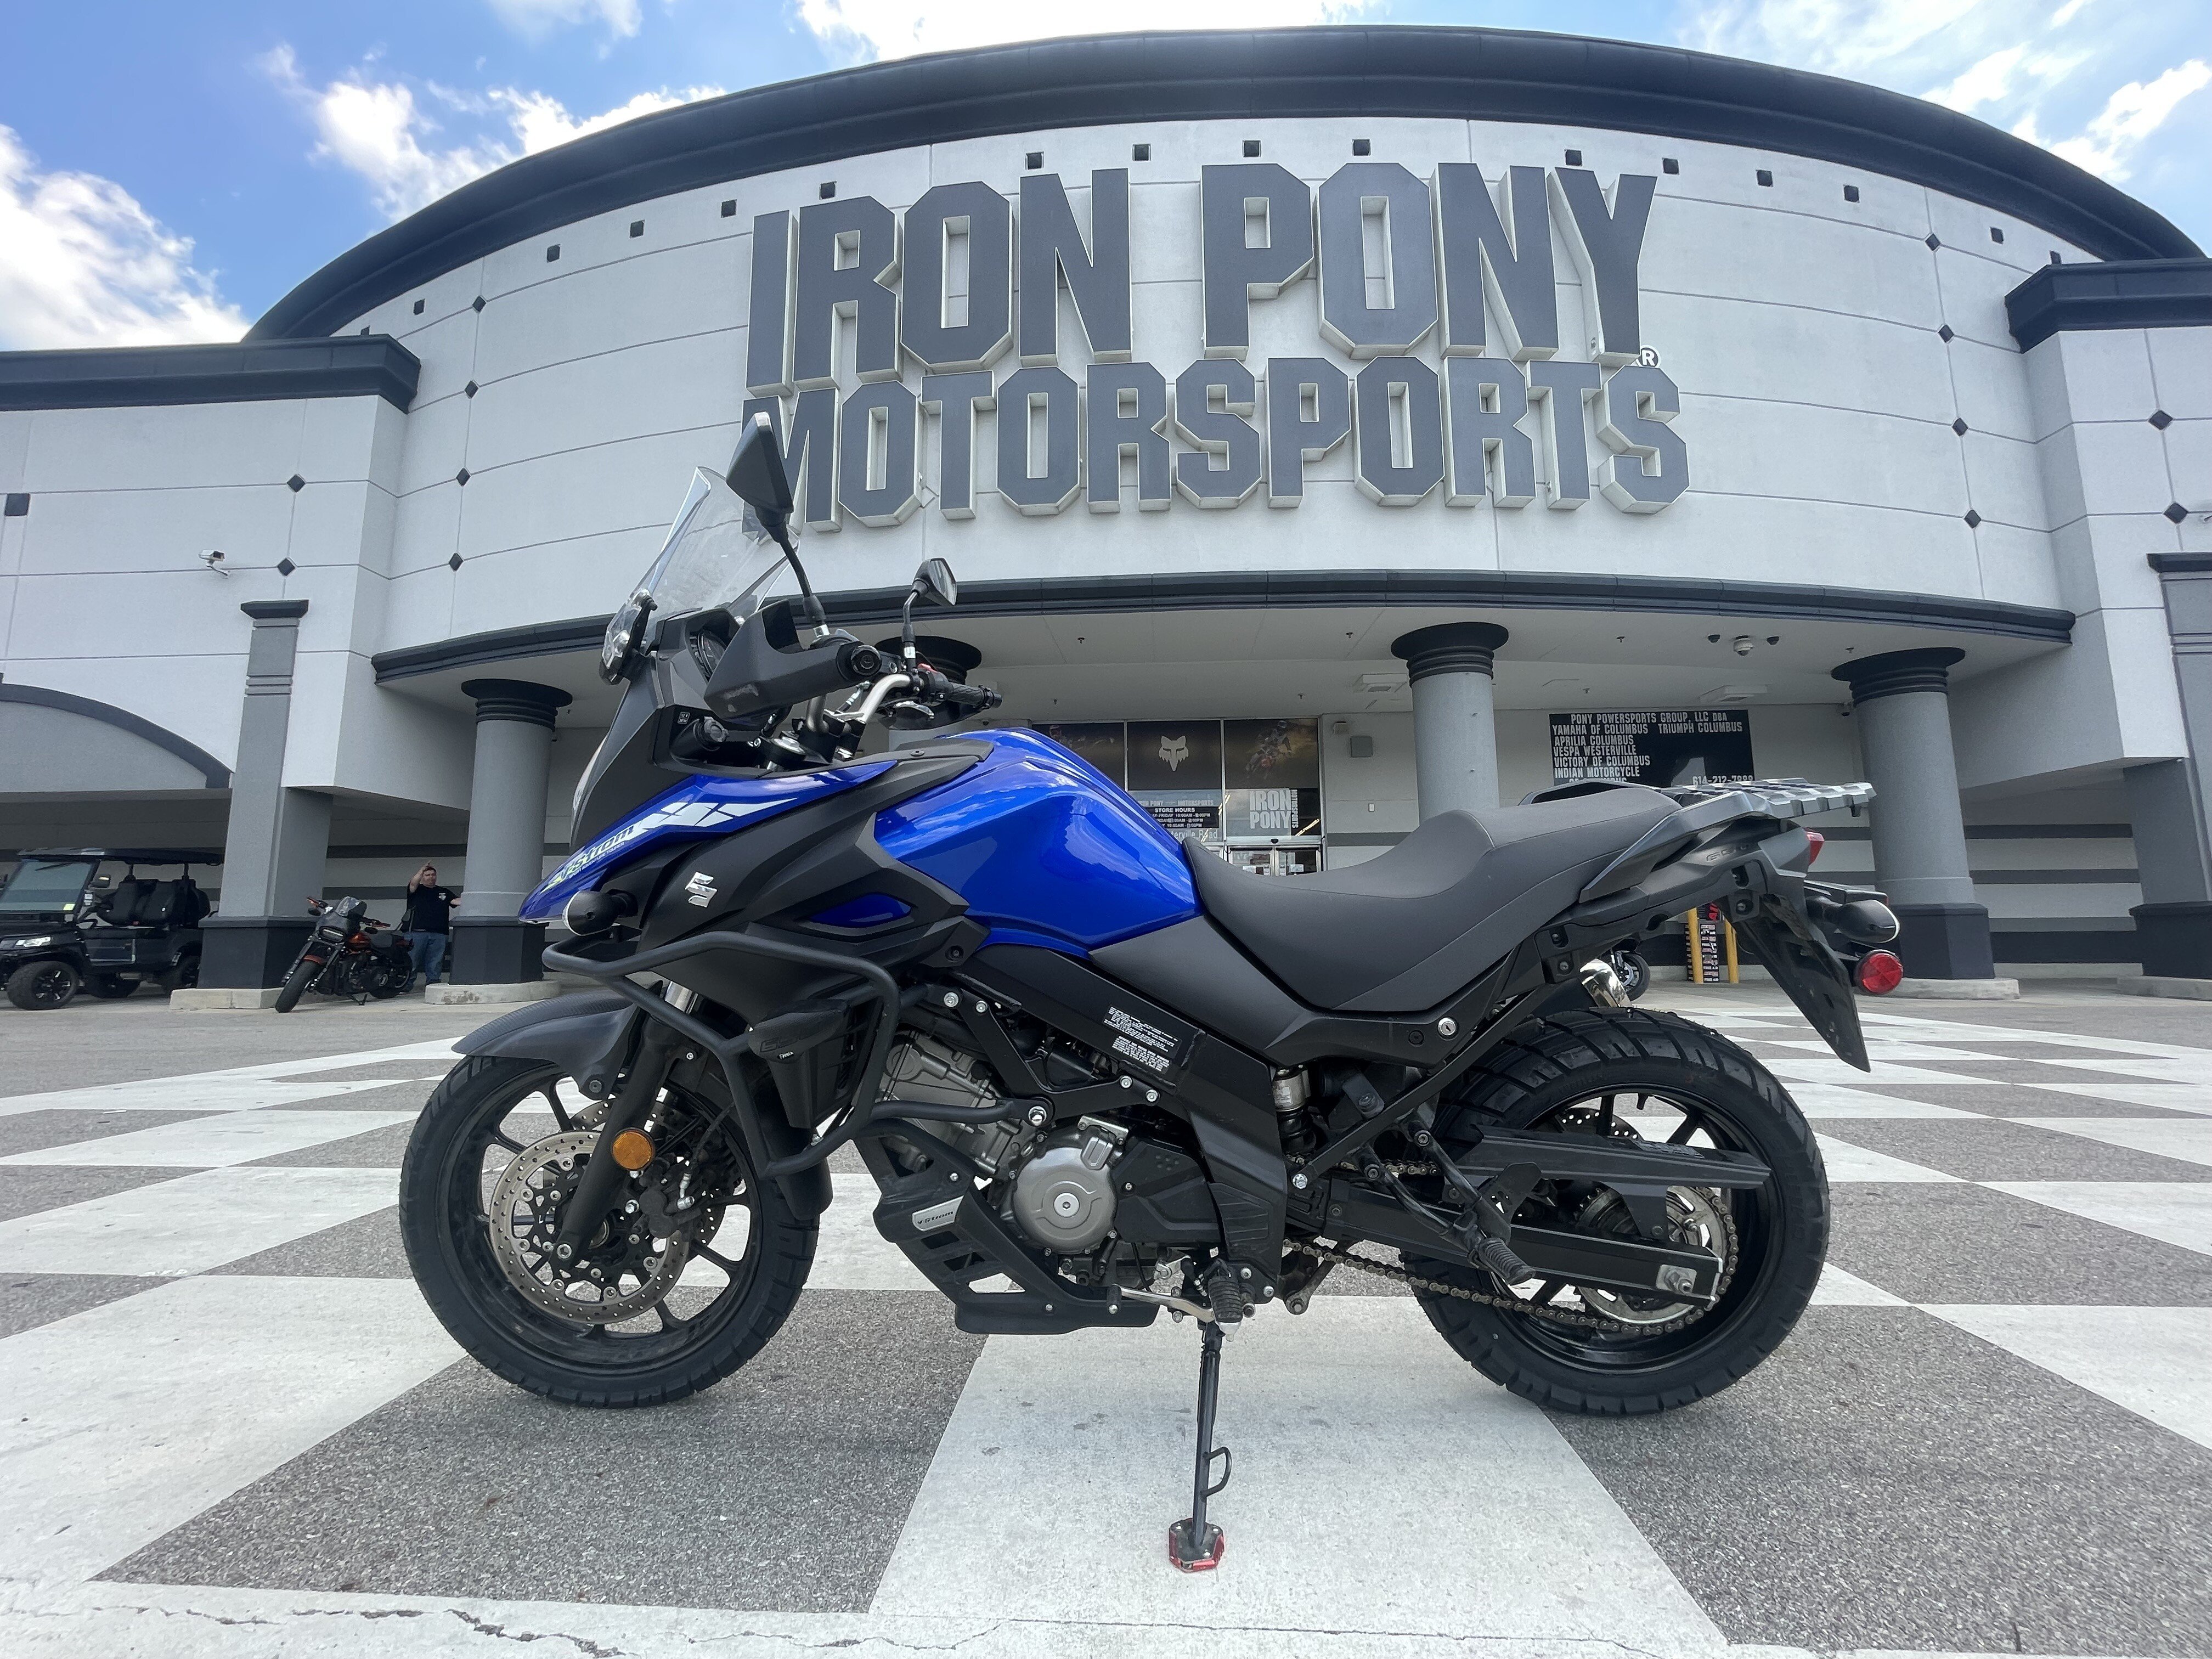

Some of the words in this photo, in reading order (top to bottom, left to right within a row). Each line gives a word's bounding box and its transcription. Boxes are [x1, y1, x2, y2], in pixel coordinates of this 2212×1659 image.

[747, 168, 1131, 395] IRON
[1201, 162, 1657, 360] PONY
[742, 357, 1690, 535] MOTORSPORTS
[1571, 714, 1592, 724] PONY
[1597, 713, 1657, 724] POWERSPORTS
[1695, 712, 1709, 721] LLC
[1713, 712, 1728, 721] DBA
[1552, 725, 1587, 735] YAMAHA
[1591, 724, 1601, 735] OF
[1604, 724, 1649, 734] COLUMBUS
[1658, 723, 1694, 734] TRIUMPH
[1697, 721, 1743, 732] COLUMBUS
[1554, 736, 1587, 747] APRILIA
[1590, 735, 1634, 746] COLUMBUS
[1553, 746, 1580, 757] VESPA
[1584, 745, 1637, 756] WESTERVILLE
[1554, 757, 1589, 768] VICTORY
[1592, 756, 1602, 766] OF
[1606, 755, 1650, 766] COLUMBUS
[1555, 768, 1583, 778] INDIAN
[1587, 766, 1640, 777] MOTORCYCLE
[1250, 789, 1291, 811] IRON
[1250, 811, 1291, 829] PONY
[1171, 830, 1196, 840] terville
[1199, 829, 1218, 839] Rad
